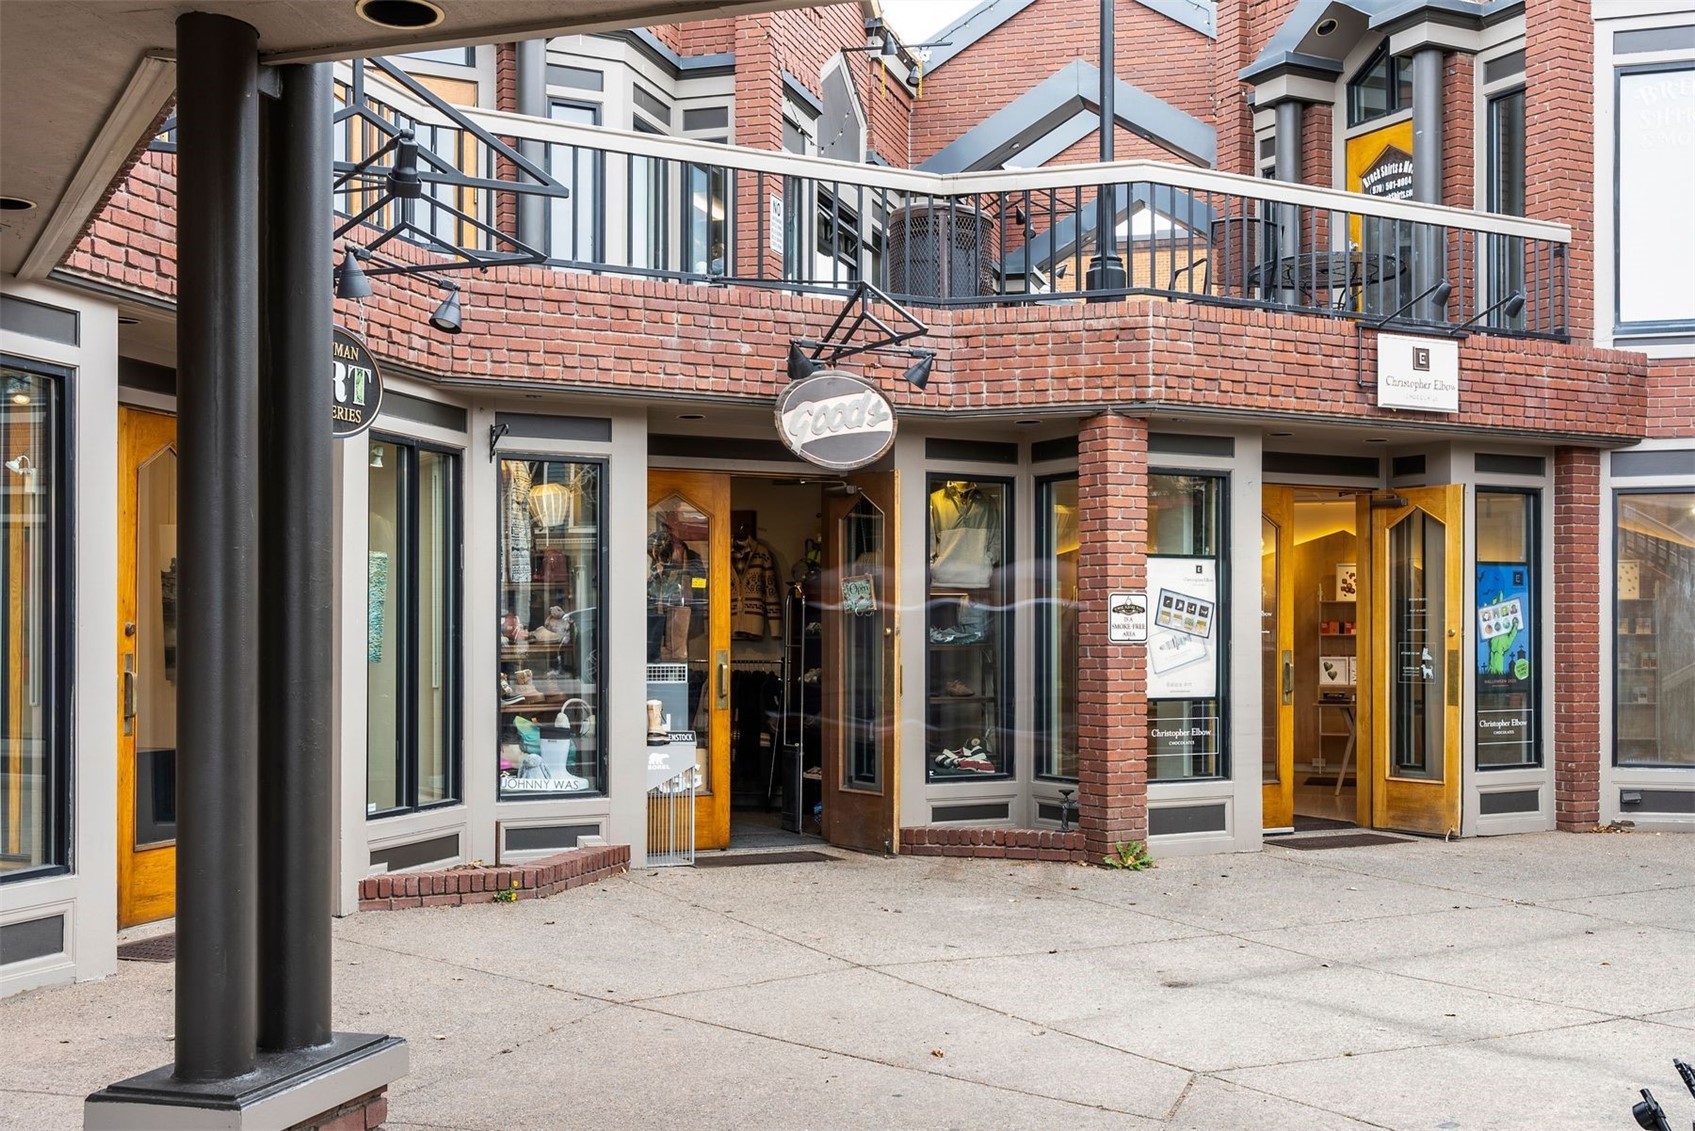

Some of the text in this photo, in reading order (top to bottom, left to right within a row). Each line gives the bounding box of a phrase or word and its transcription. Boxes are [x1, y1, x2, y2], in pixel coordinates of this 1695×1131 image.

[333, 342, 359, 361] MAN
[1386, 375, 1456, 391] Christopher Elbow
[849, 583, 869, 595] Open
[1480, 718, 1527, 729] Christopher Elbow
[1151, 727, 1211, 739] Christopher Elbow
[503, 780, 579, 790] JOHNNY WAS
